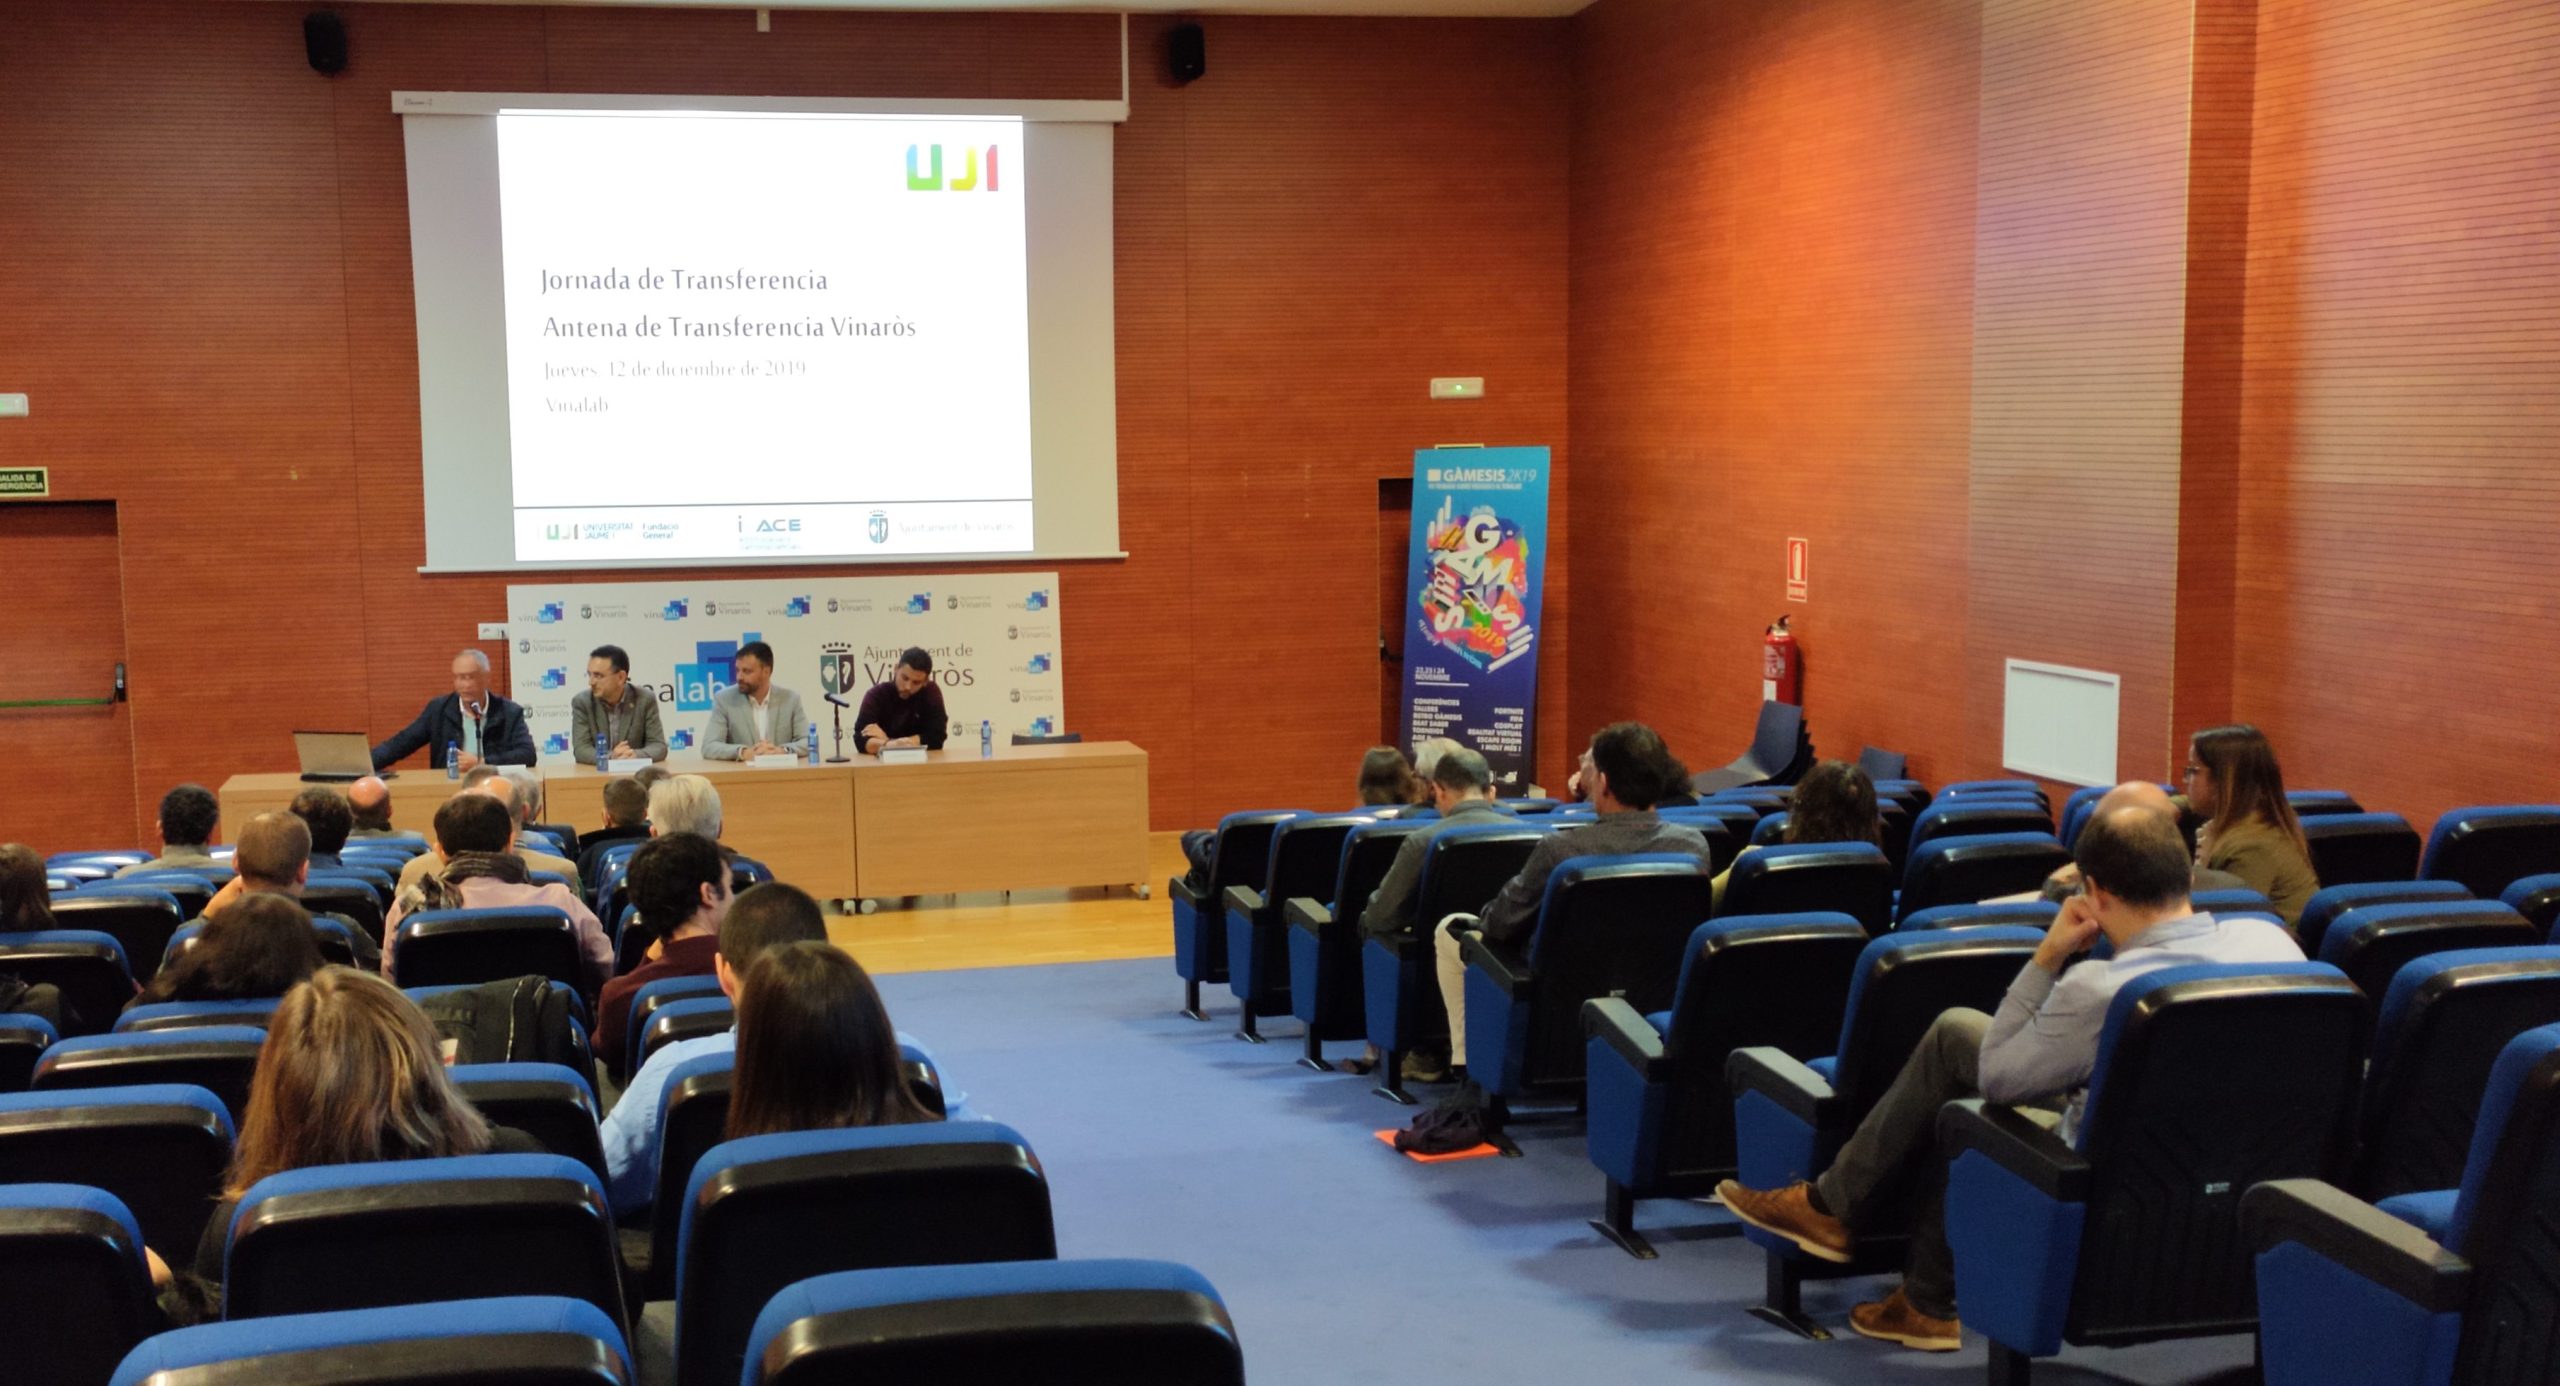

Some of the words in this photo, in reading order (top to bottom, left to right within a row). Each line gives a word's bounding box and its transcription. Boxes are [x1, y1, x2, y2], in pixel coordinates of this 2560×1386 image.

[905, 143, 999, 192] UJI
[541, 266, 631, 295] Jornada
[637, 267, 665, 290] de
[671, 268, 828, 290] Transferencia
[543, 316, 628, 338] Antena
[635, 315, 661, 338] de
[668, 315, 825, 338] Transferencia
[830, 315, 916, 338] Vinaròs
[610, 360, 626, 377] 12
[632, 359, 651, 377] de
[656, 359, 736, 377] diciembre
[741, 359, 760, 377] de
[765, 359, 806, 377] 2019
[1443, 467, 1505, 482] GÀMESIS
[1507, 468, 1537, 482] 2K19
[642, 531, 674, 541] General
[863, 645, 950, 663] Ajuntent
[954, 643, 974, 657] de
[863, 661, 975, 687] Viròs
